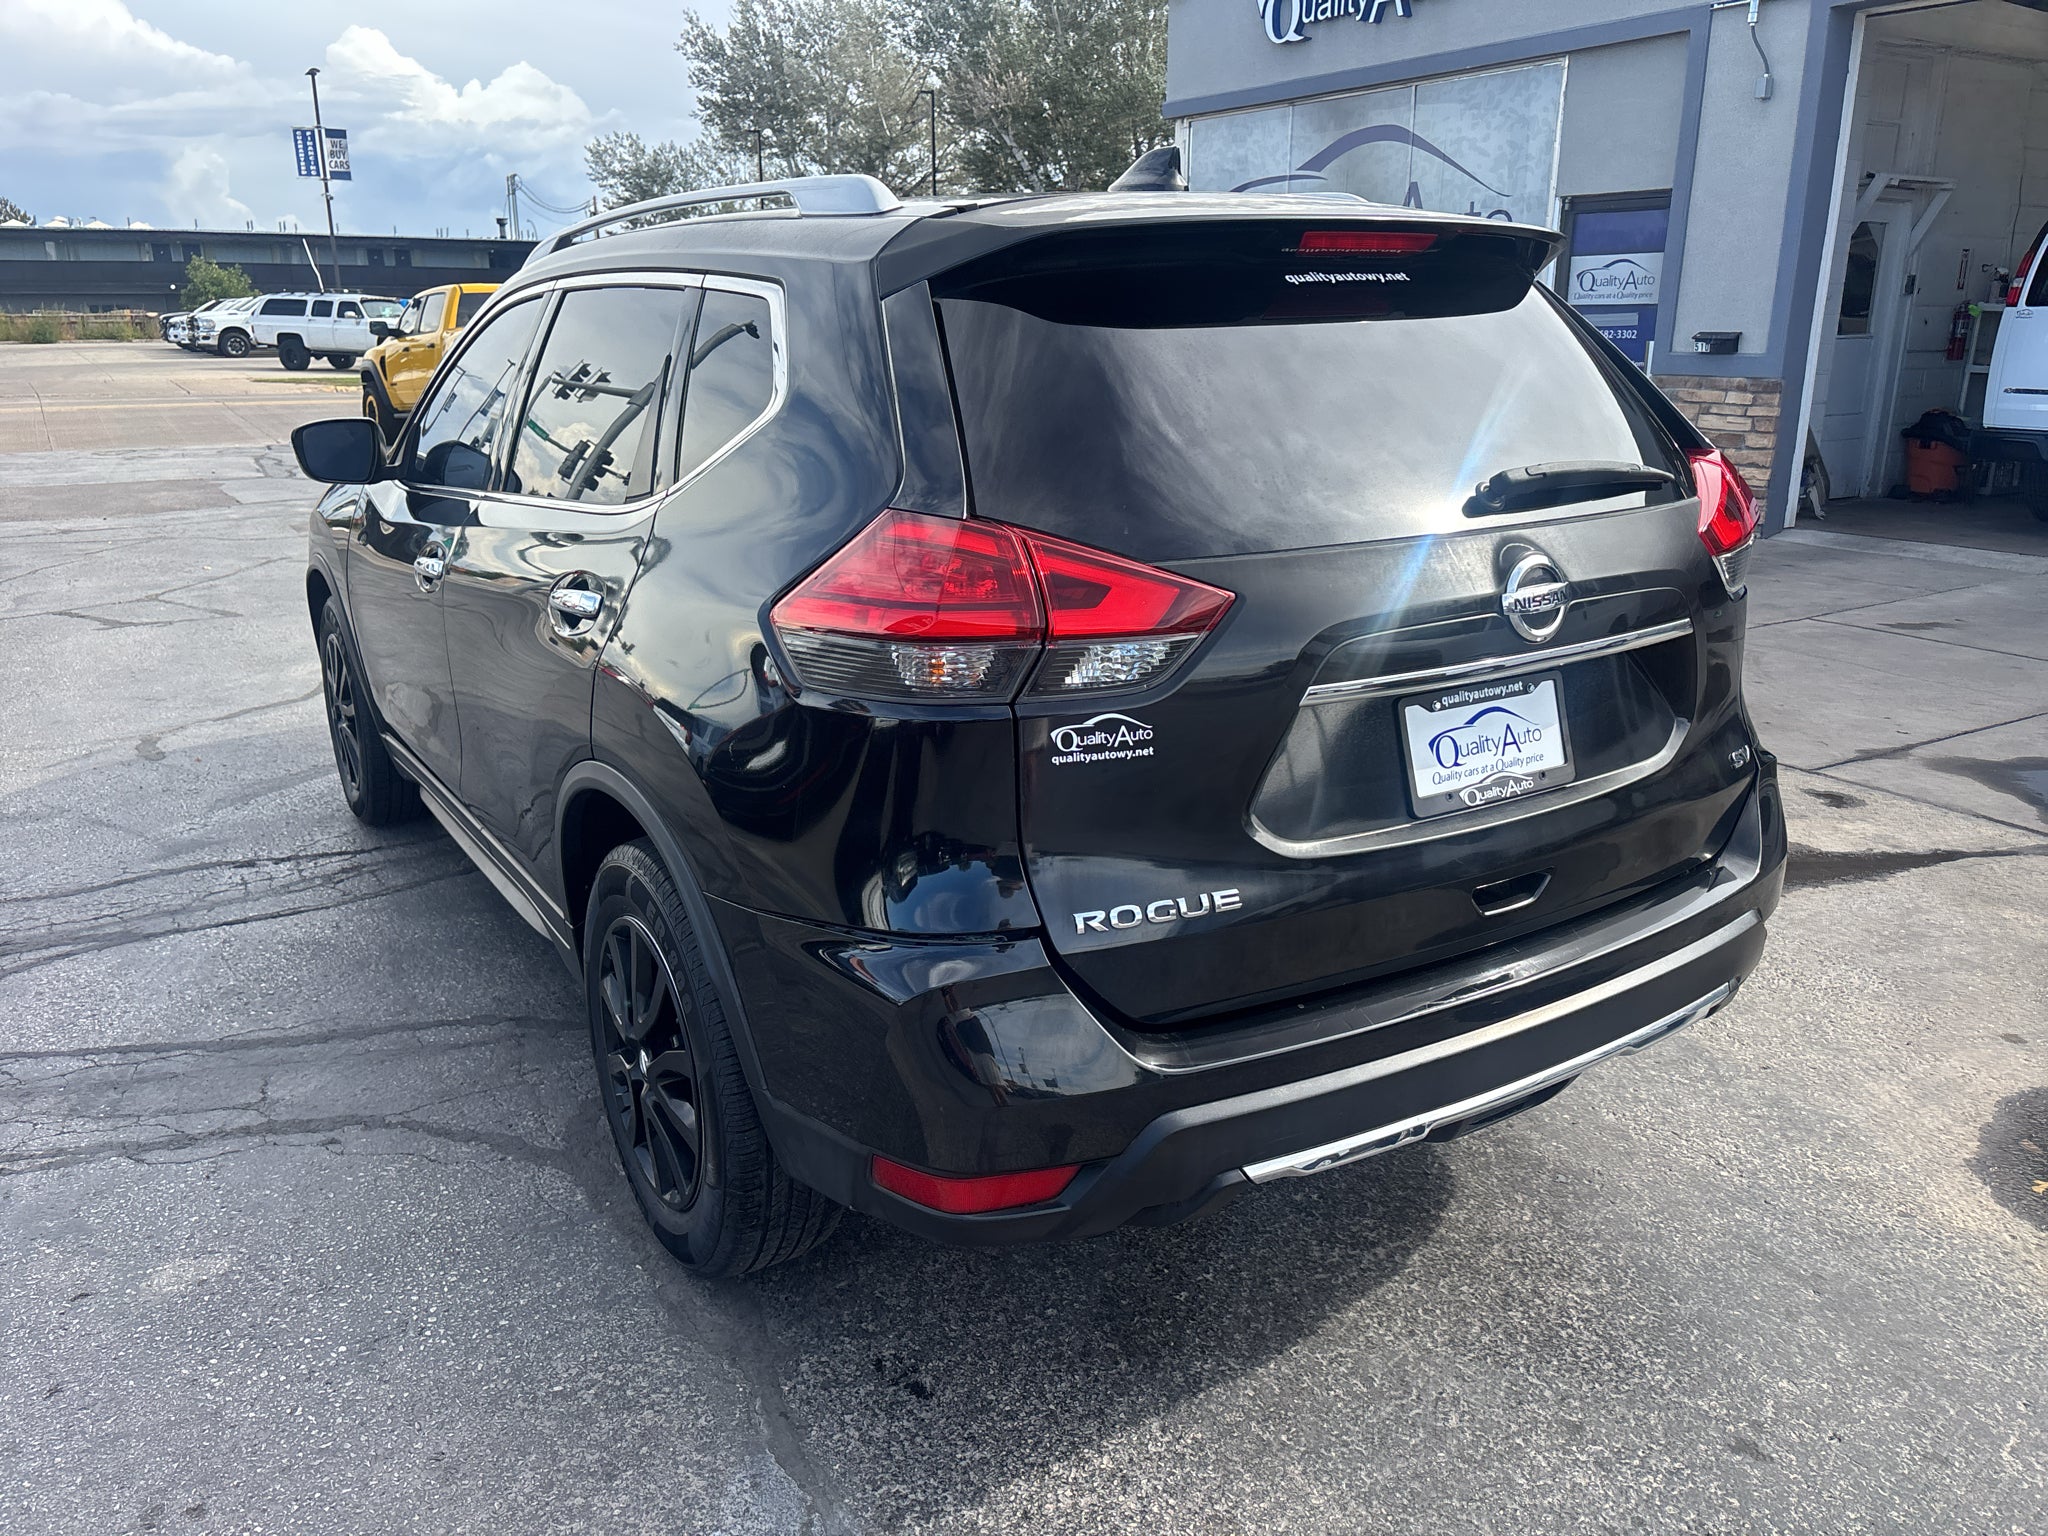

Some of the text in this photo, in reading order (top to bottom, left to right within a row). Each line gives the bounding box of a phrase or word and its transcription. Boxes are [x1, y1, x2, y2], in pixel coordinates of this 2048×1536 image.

[329, 150, 346, 159] BUY
[330, 140, 343, 149] WE
[328, 160, 350, 170] CARS
[1284, 271, 1411, 285] qualityautowy.net
[1579, 270, 1656, 292] QualityAuto
[1598, 329, 1638, 339] 82-3302
[1513, 589, 1568, 611] NISSAN
[1441, 681, 1524, 707] qualityautowy.net
[1056, 725, 1153, 752] QualityAuto
[1435, 723, 1543, 769] QualityAuto
[1051, 746, 1154, 766] qualityautowy.net
[1728, 745, 1750, 769] SV
[1432, 769, 1463, 785] Quality
[1463, 766, 1480, 778] cars
[1480, 764, 1489, 774] at
[1495, 758, 1525, 774] Quality
[1525, 753, 1544, 765] price
[1462, 779, 1534, 807] QualityAuto
[1072, 888, 1243, 935] ROGUE
